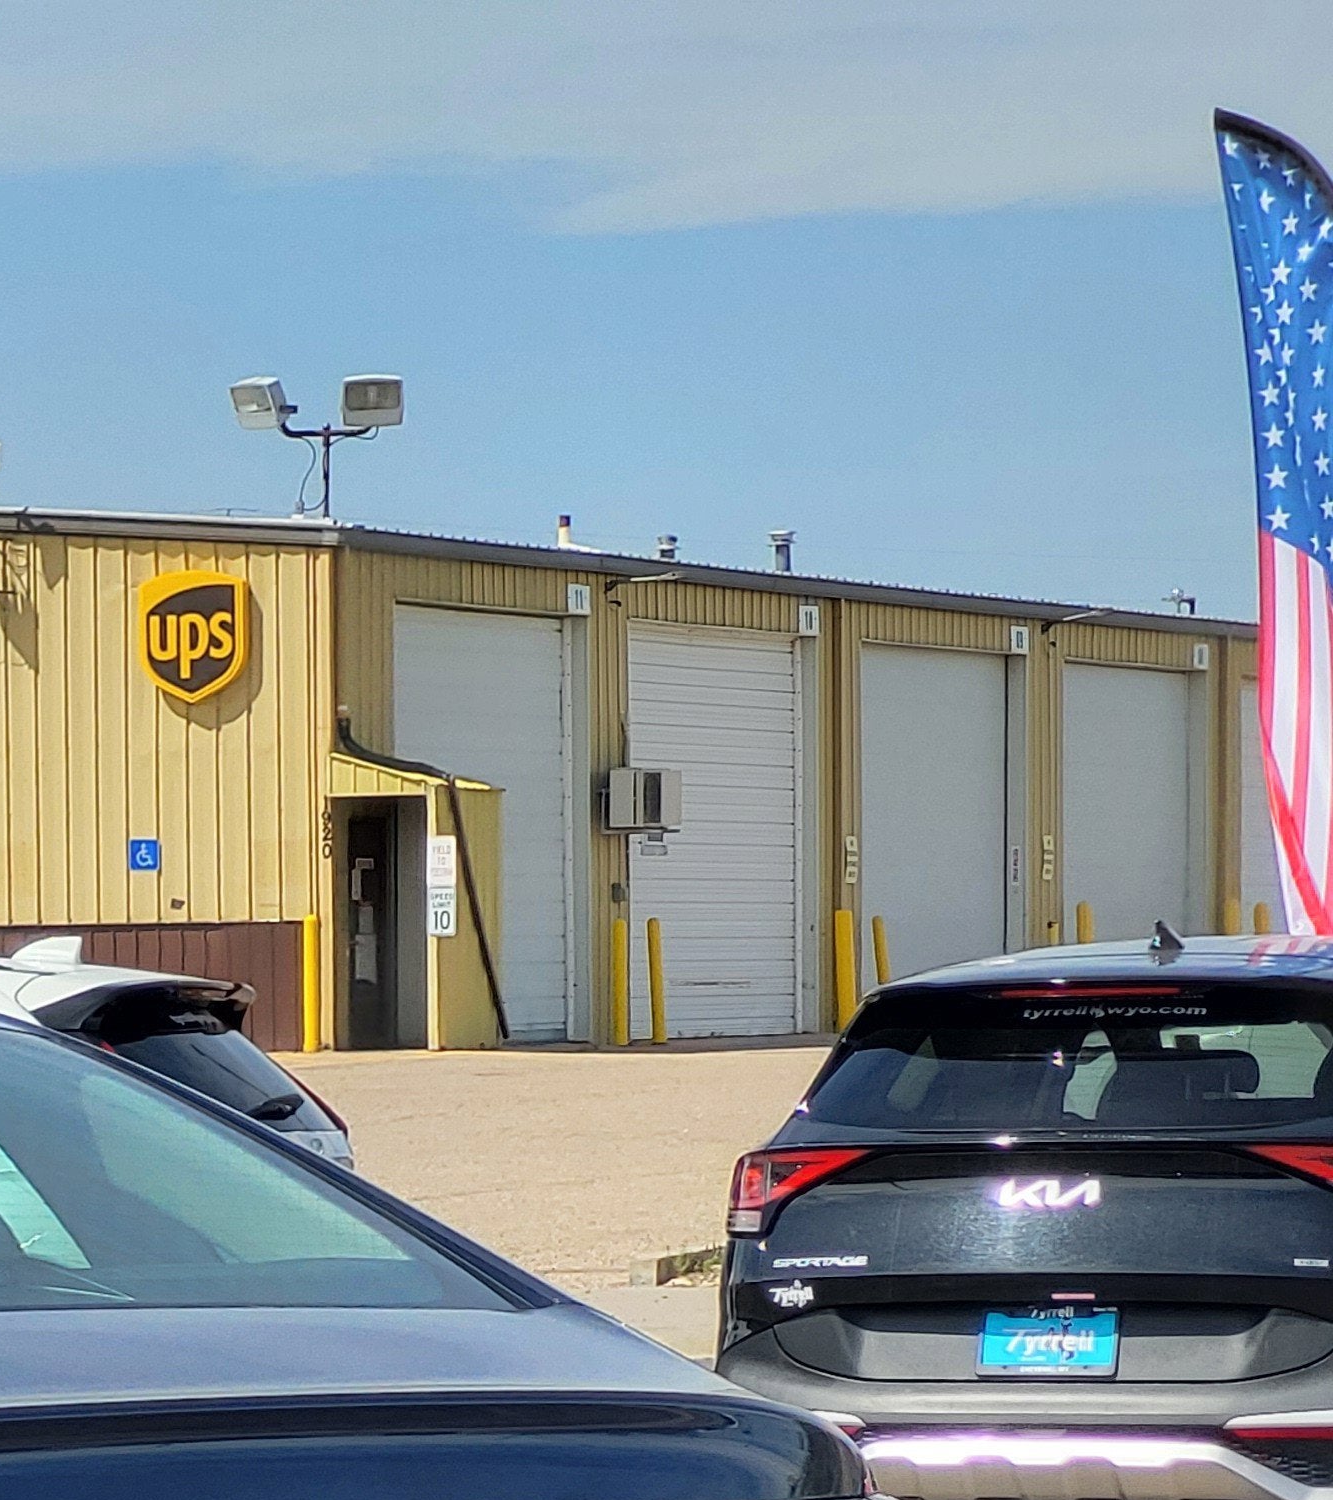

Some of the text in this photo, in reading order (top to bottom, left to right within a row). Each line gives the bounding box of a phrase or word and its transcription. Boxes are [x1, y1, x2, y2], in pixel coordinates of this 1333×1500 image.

[148, 611, 234, 680] ups
[433, 910, 451, 930] 10
[772, 1255, 869, 1268] SPORTAGE
[1001, 1329, 1096, 1357] Tyrrell
